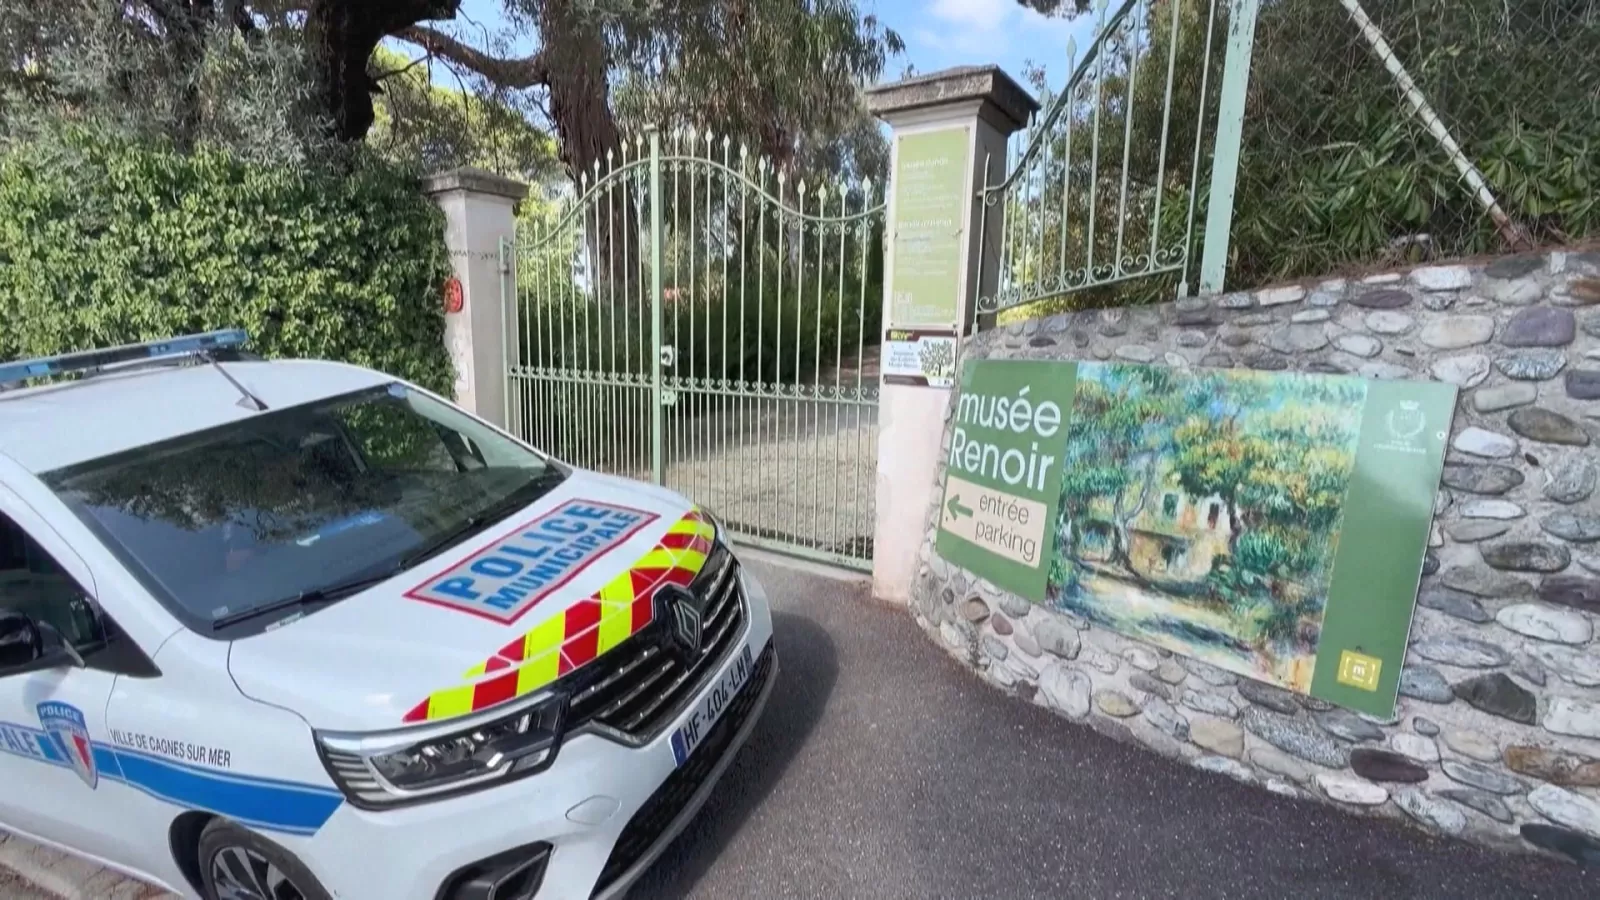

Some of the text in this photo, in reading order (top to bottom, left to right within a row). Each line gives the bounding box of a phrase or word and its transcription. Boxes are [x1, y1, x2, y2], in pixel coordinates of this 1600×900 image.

[957, 384, 1061, 437] musée
[949, 427, 1054, 492] Renoir
[979, 494, 1029, 525] entrée
[432, 504, 611, 600] POLICE
[483, 512, 641, 611] MUNICIPALE
[974, 520, 1036, 562] parking
[40, 704, 80, 722] POLICE
[0, 727, 41, 756] ALE
[110, 728, 231, 769] VILLE DE CAGNES SUR MER
